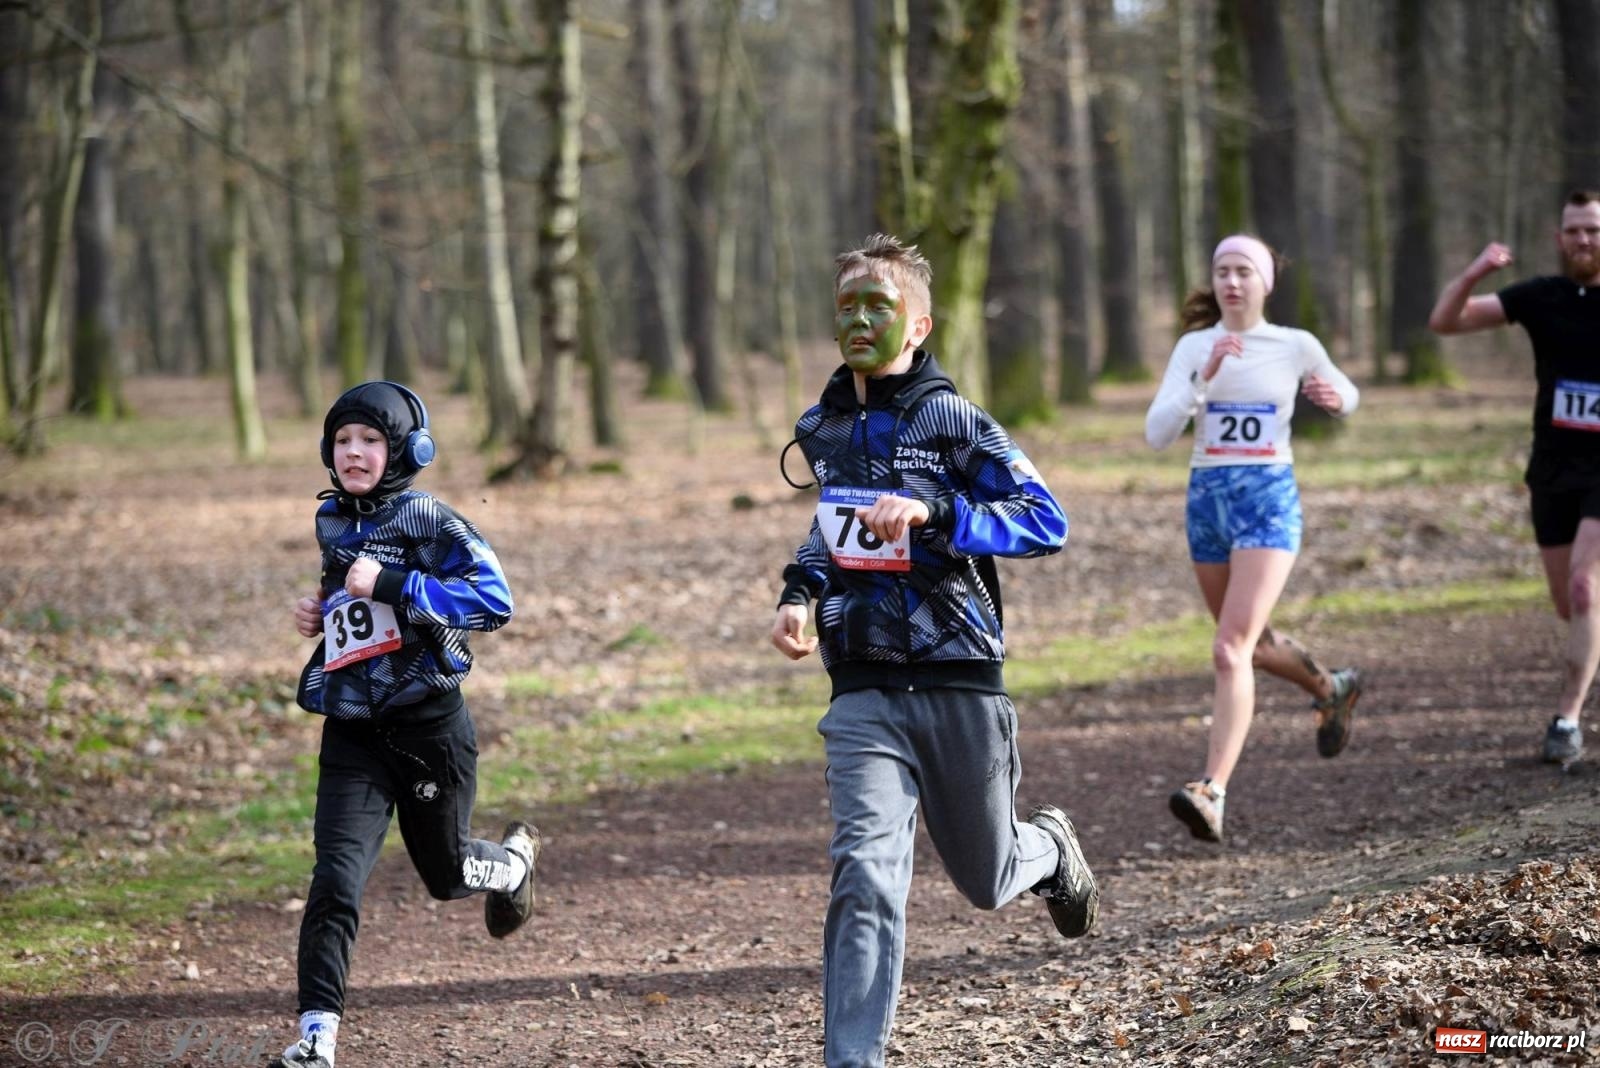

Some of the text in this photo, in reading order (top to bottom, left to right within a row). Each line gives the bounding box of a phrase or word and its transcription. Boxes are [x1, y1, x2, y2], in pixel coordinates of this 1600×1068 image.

[1220, 416, 1261, 442] 20
[895, 446, 940, 463] Zapasy
[852, 489, 897, 498] TWARDZA
[835, 506, 884, 551] 78
[362, 541, 404, 556] Zapasy
[358, 550, 406, 565] Racibórz
[332, 601, 374, 649] 39
